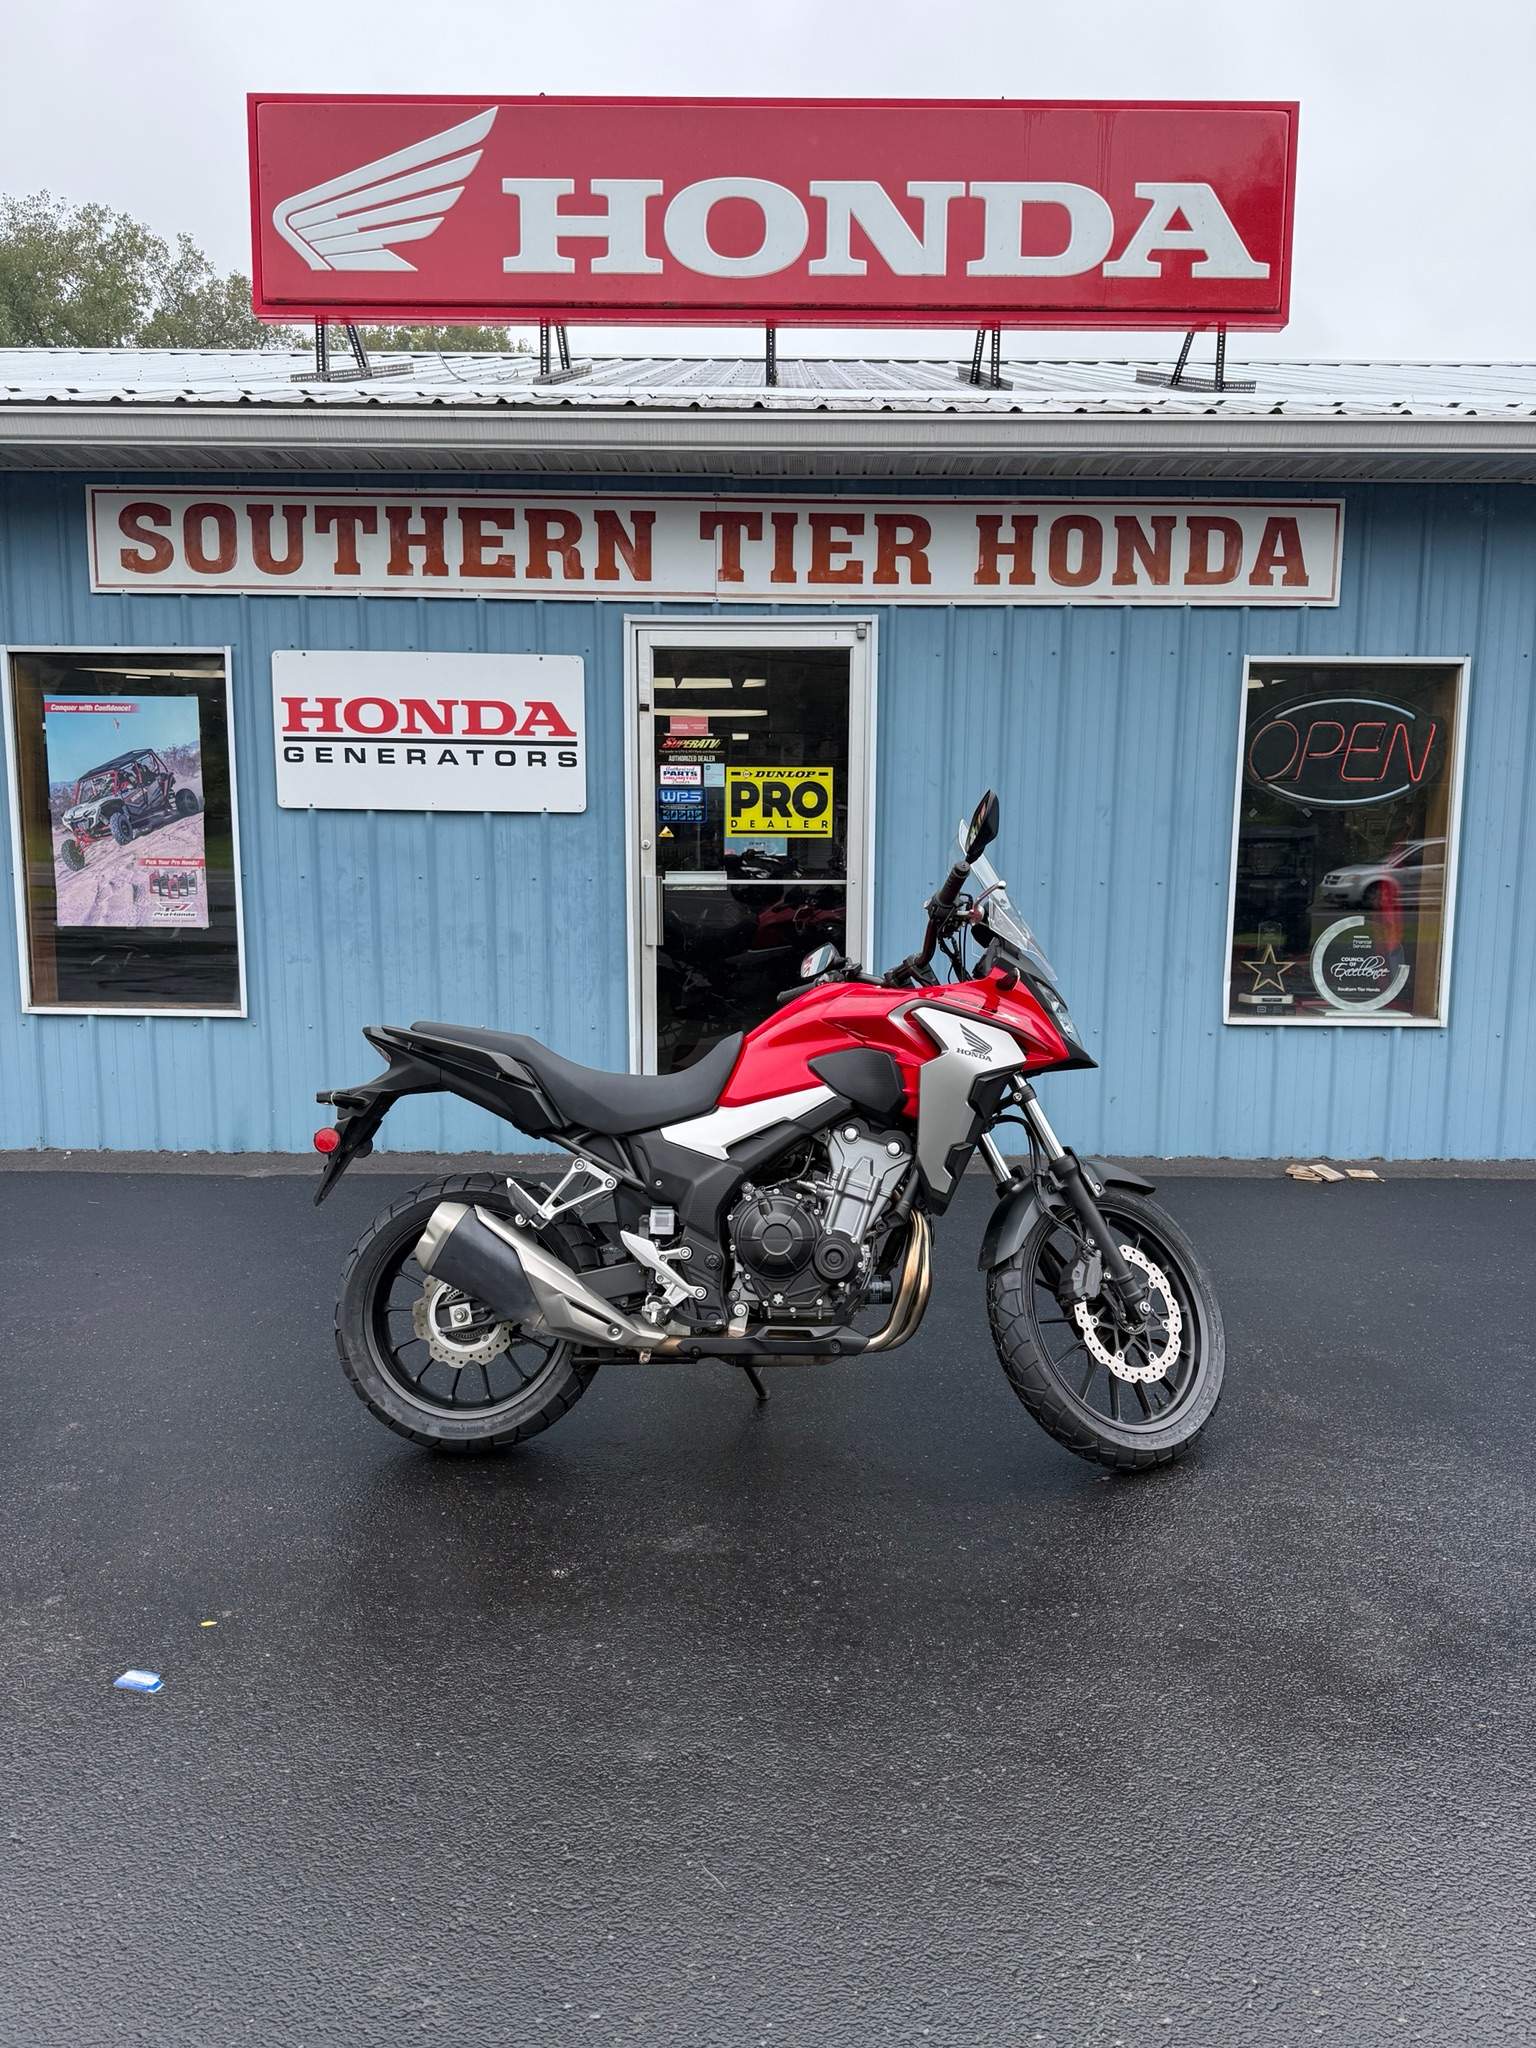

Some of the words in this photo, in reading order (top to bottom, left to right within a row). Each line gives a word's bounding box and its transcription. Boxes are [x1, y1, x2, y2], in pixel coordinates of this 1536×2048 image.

[501, 176, 1270, 280] HONDA
[117, 501, 657, 582] SOUTHERN
[699, 511, 933, 586] TIER
[973, 513, 1311, 588] HONDA
[50, 703, 78, 713] Conquer
[79, 704, 93, 712] with
[94, 704, 132, 713] Confidence!
[280, 696, 578, 737] HONDA
[283, 746, 578, 768] GENERATORS
[668, 754, 698, 762] AUTHORIZED
[698, 754, 716, 762] DEALER
[1248, 720, 1437, 783] OPEN
[661, 791, 702, 802] WPS
[731, 781, 829, 819] PRO
[731, 820, 828, 828] DEALER
[1330, 955, 1390, 981] Excellence
[956, 1047, 993, 1063] HONDA
